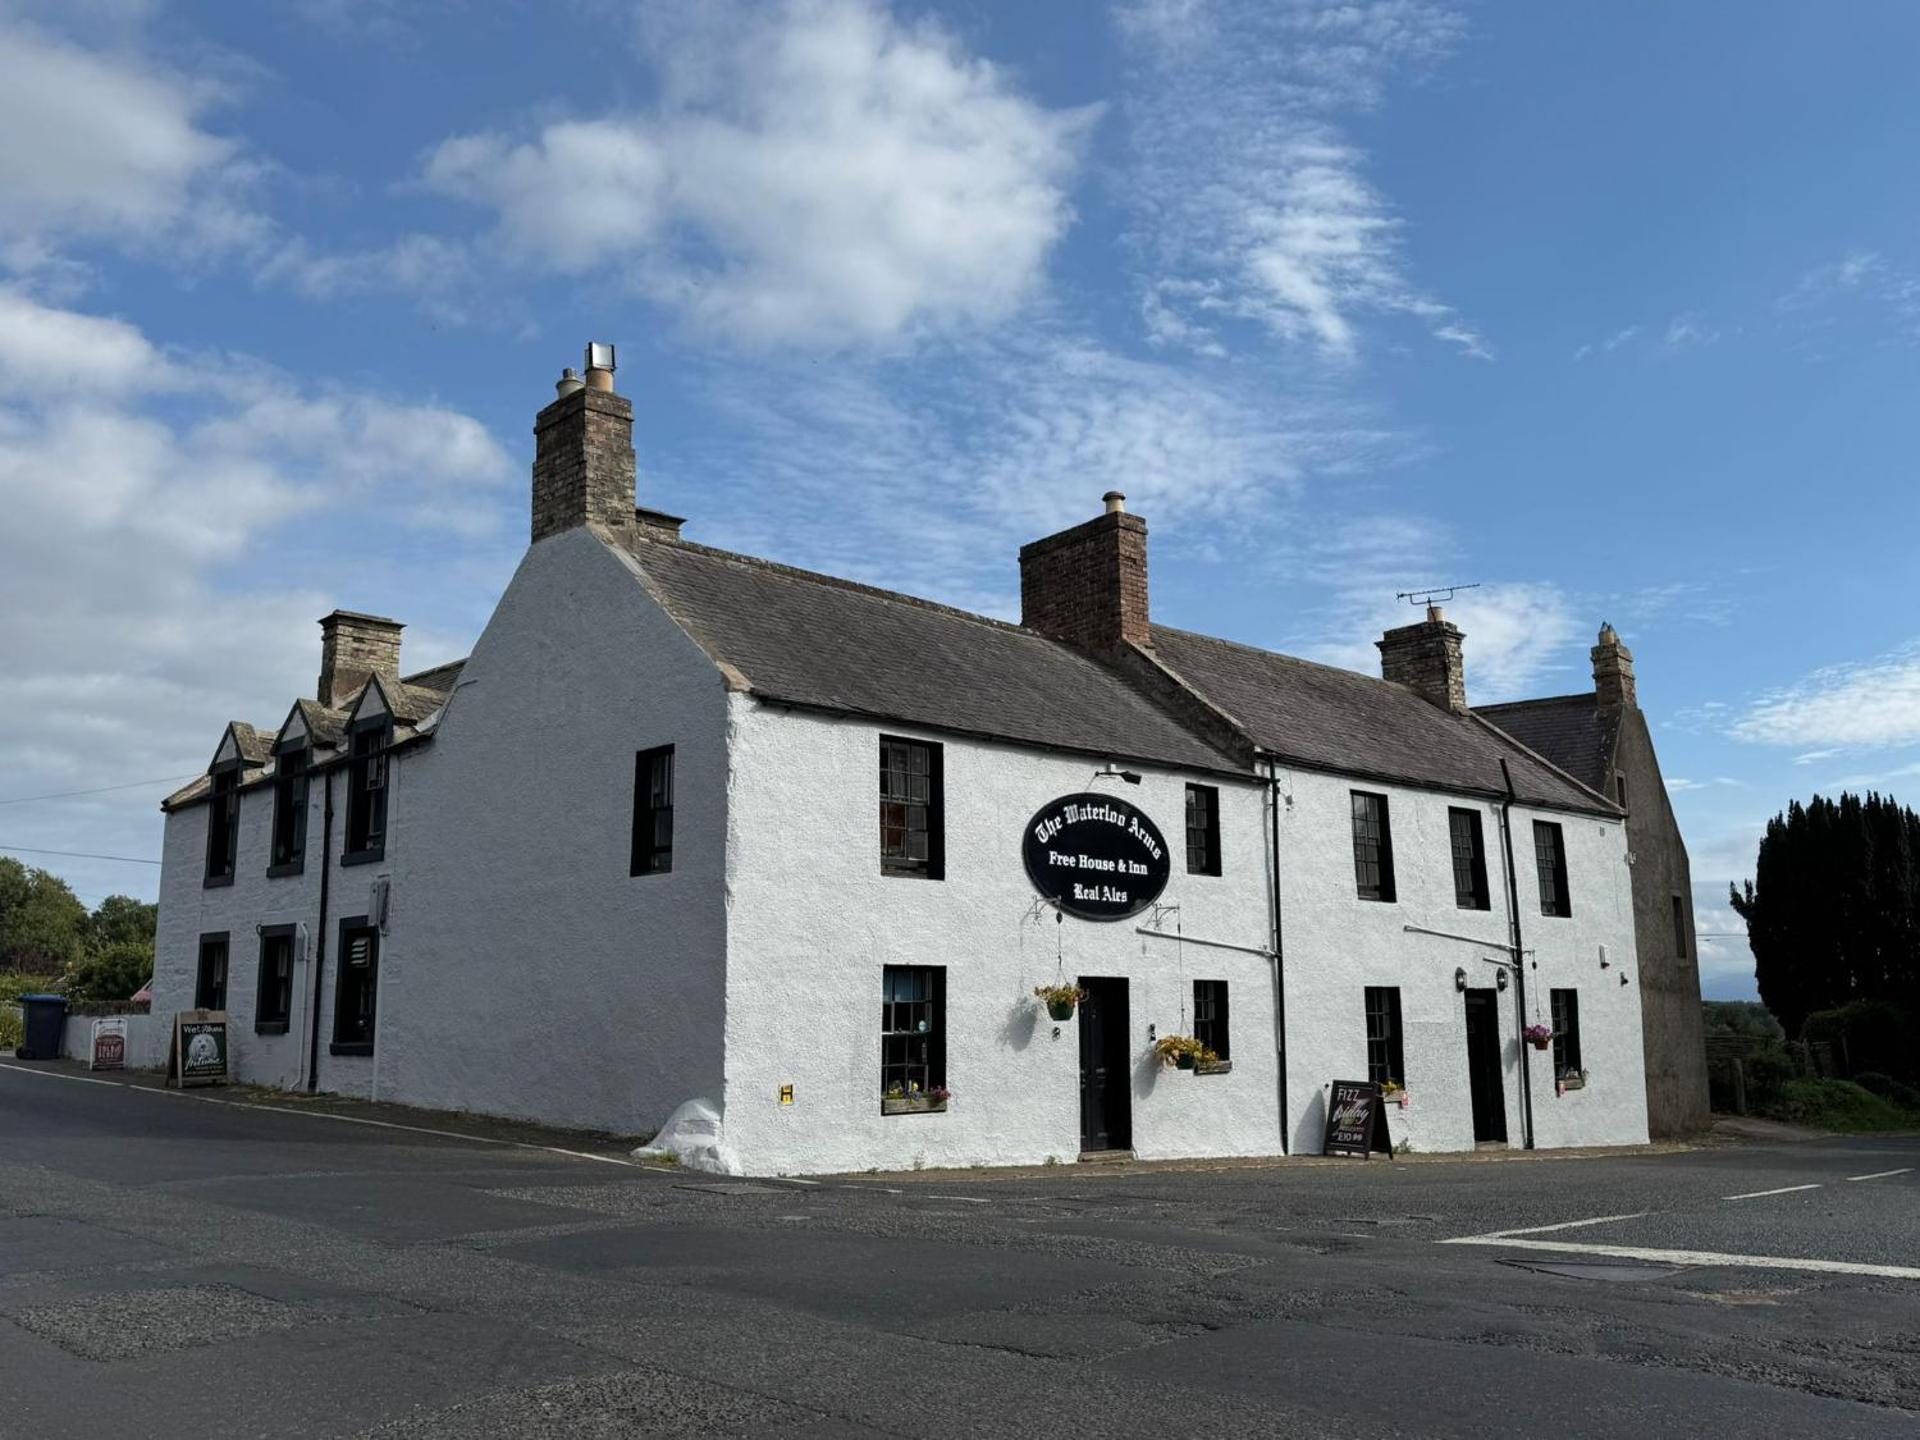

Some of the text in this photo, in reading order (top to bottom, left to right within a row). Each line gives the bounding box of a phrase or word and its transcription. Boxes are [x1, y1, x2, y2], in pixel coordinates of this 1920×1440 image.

[1035, 803, 1162, 860] The Waterloo Arms
[1049, 851, 1148, 875] Free House & Inn
[1073, 883, 1127, 902] Real Ales
[1337, 1088, 1360, 1101] FIZZ
